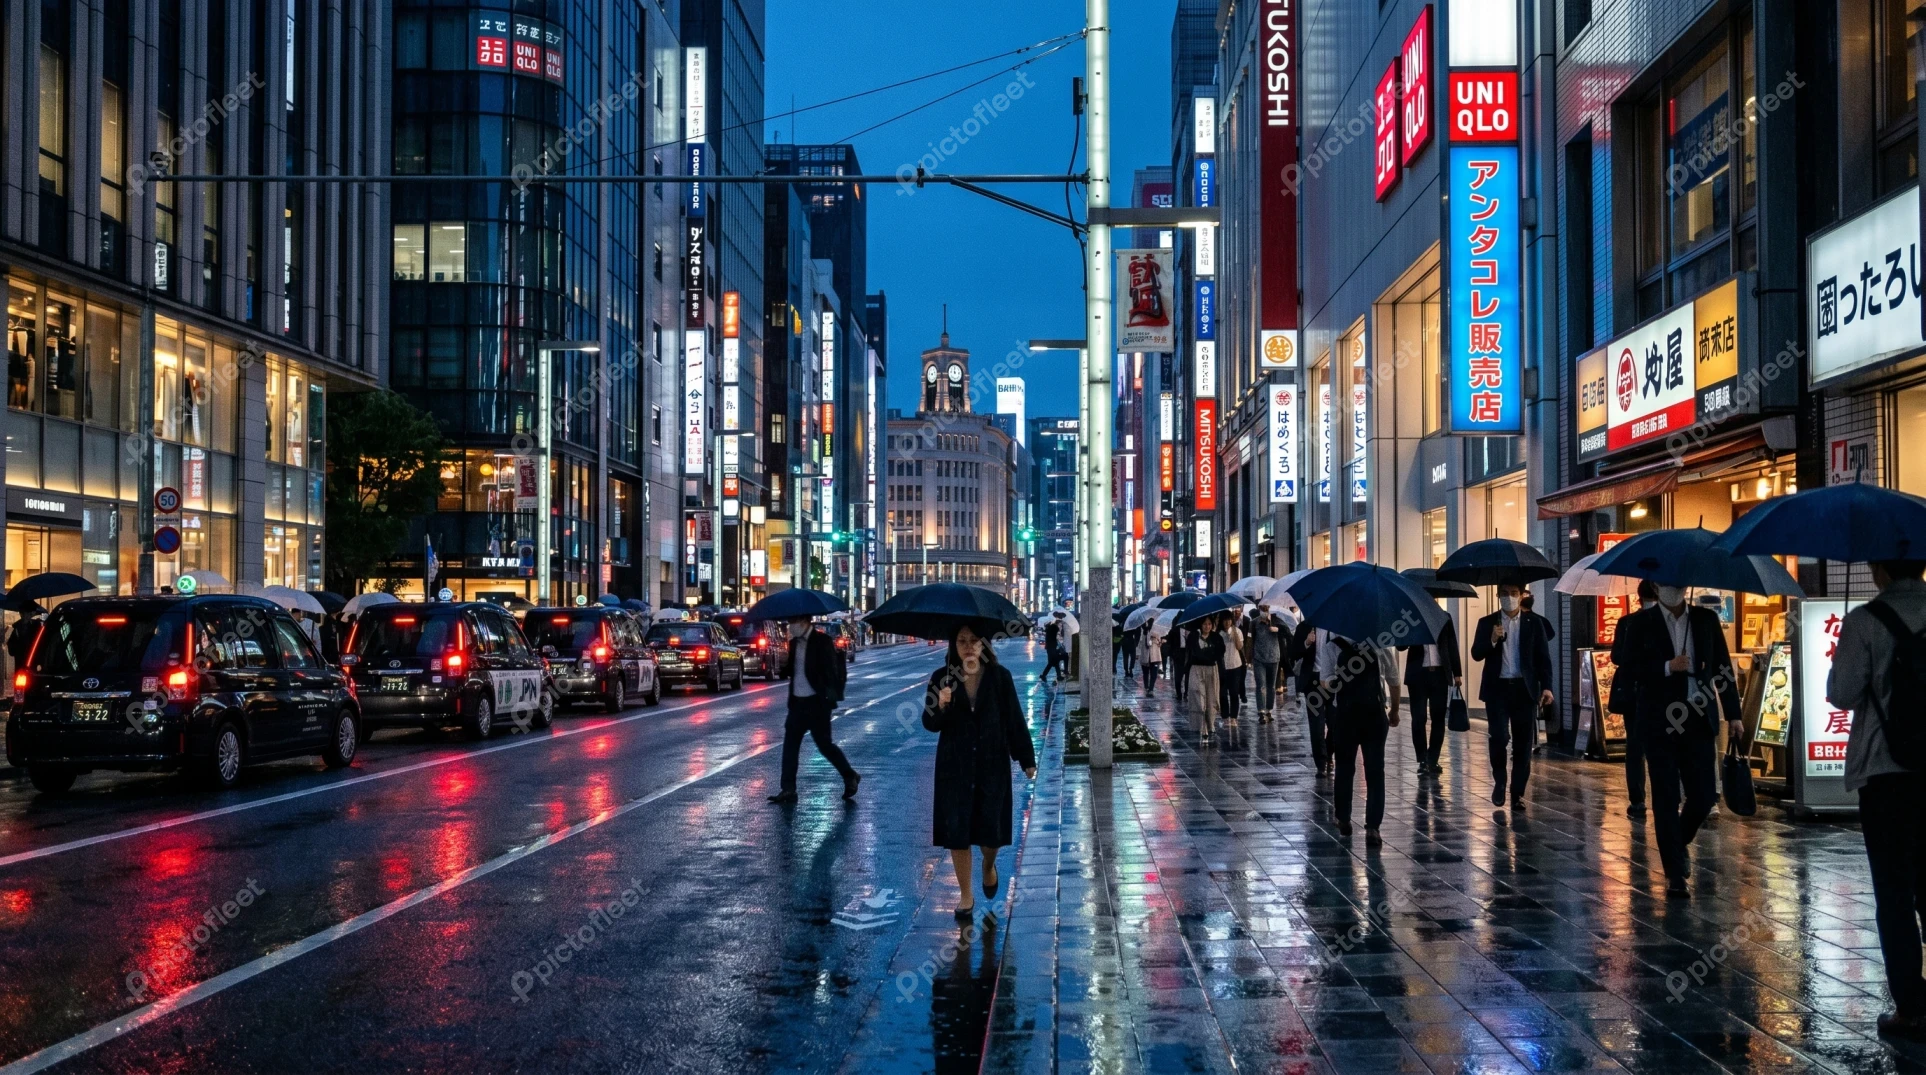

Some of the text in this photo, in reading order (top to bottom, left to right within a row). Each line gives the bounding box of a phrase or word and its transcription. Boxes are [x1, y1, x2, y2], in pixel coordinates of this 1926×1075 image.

[516, 44, 536, 58] UNI
[546, 52, 560, 65] UNI
[1404, 28, 1423, 95] UNI
[516, 57, 538, 70] QLO
[1457, 81, 1504, 105] UNI
[1405, 85, 1425, 150] QLO
[1457, 108, 1509, 136] QLO
[1468, 160, 1502, 423] アンタコレ販売店
[160, 494, 175, 507] 50
